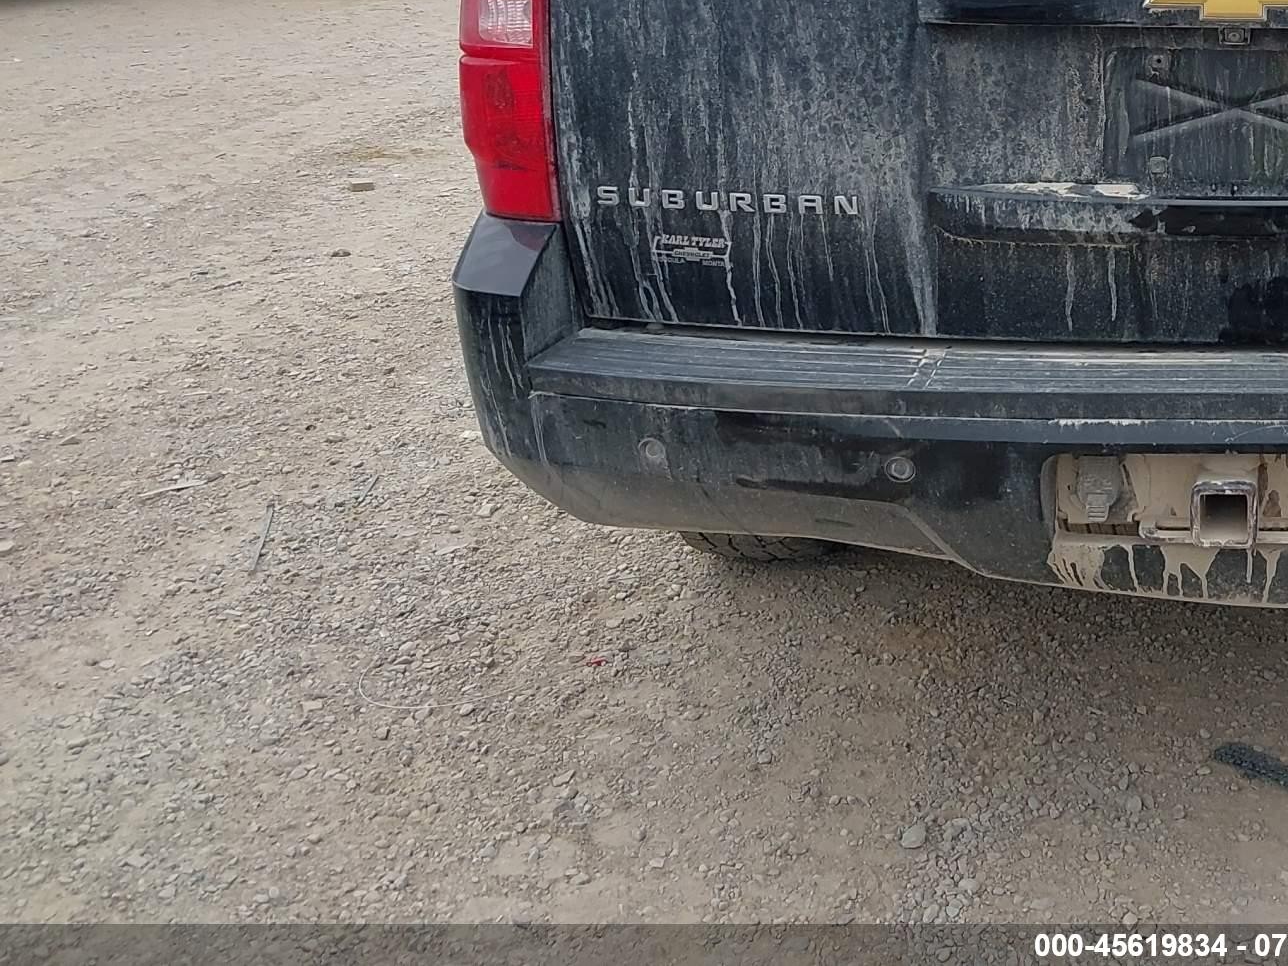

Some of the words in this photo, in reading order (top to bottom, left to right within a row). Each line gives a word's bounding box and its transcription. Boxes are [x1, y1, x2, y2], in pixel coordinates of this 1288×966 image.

[597, 186, 858, 214] SUBURBAN
[661, 234, 690, 245] KARL
[691, 237, 725, 248] TYLER
